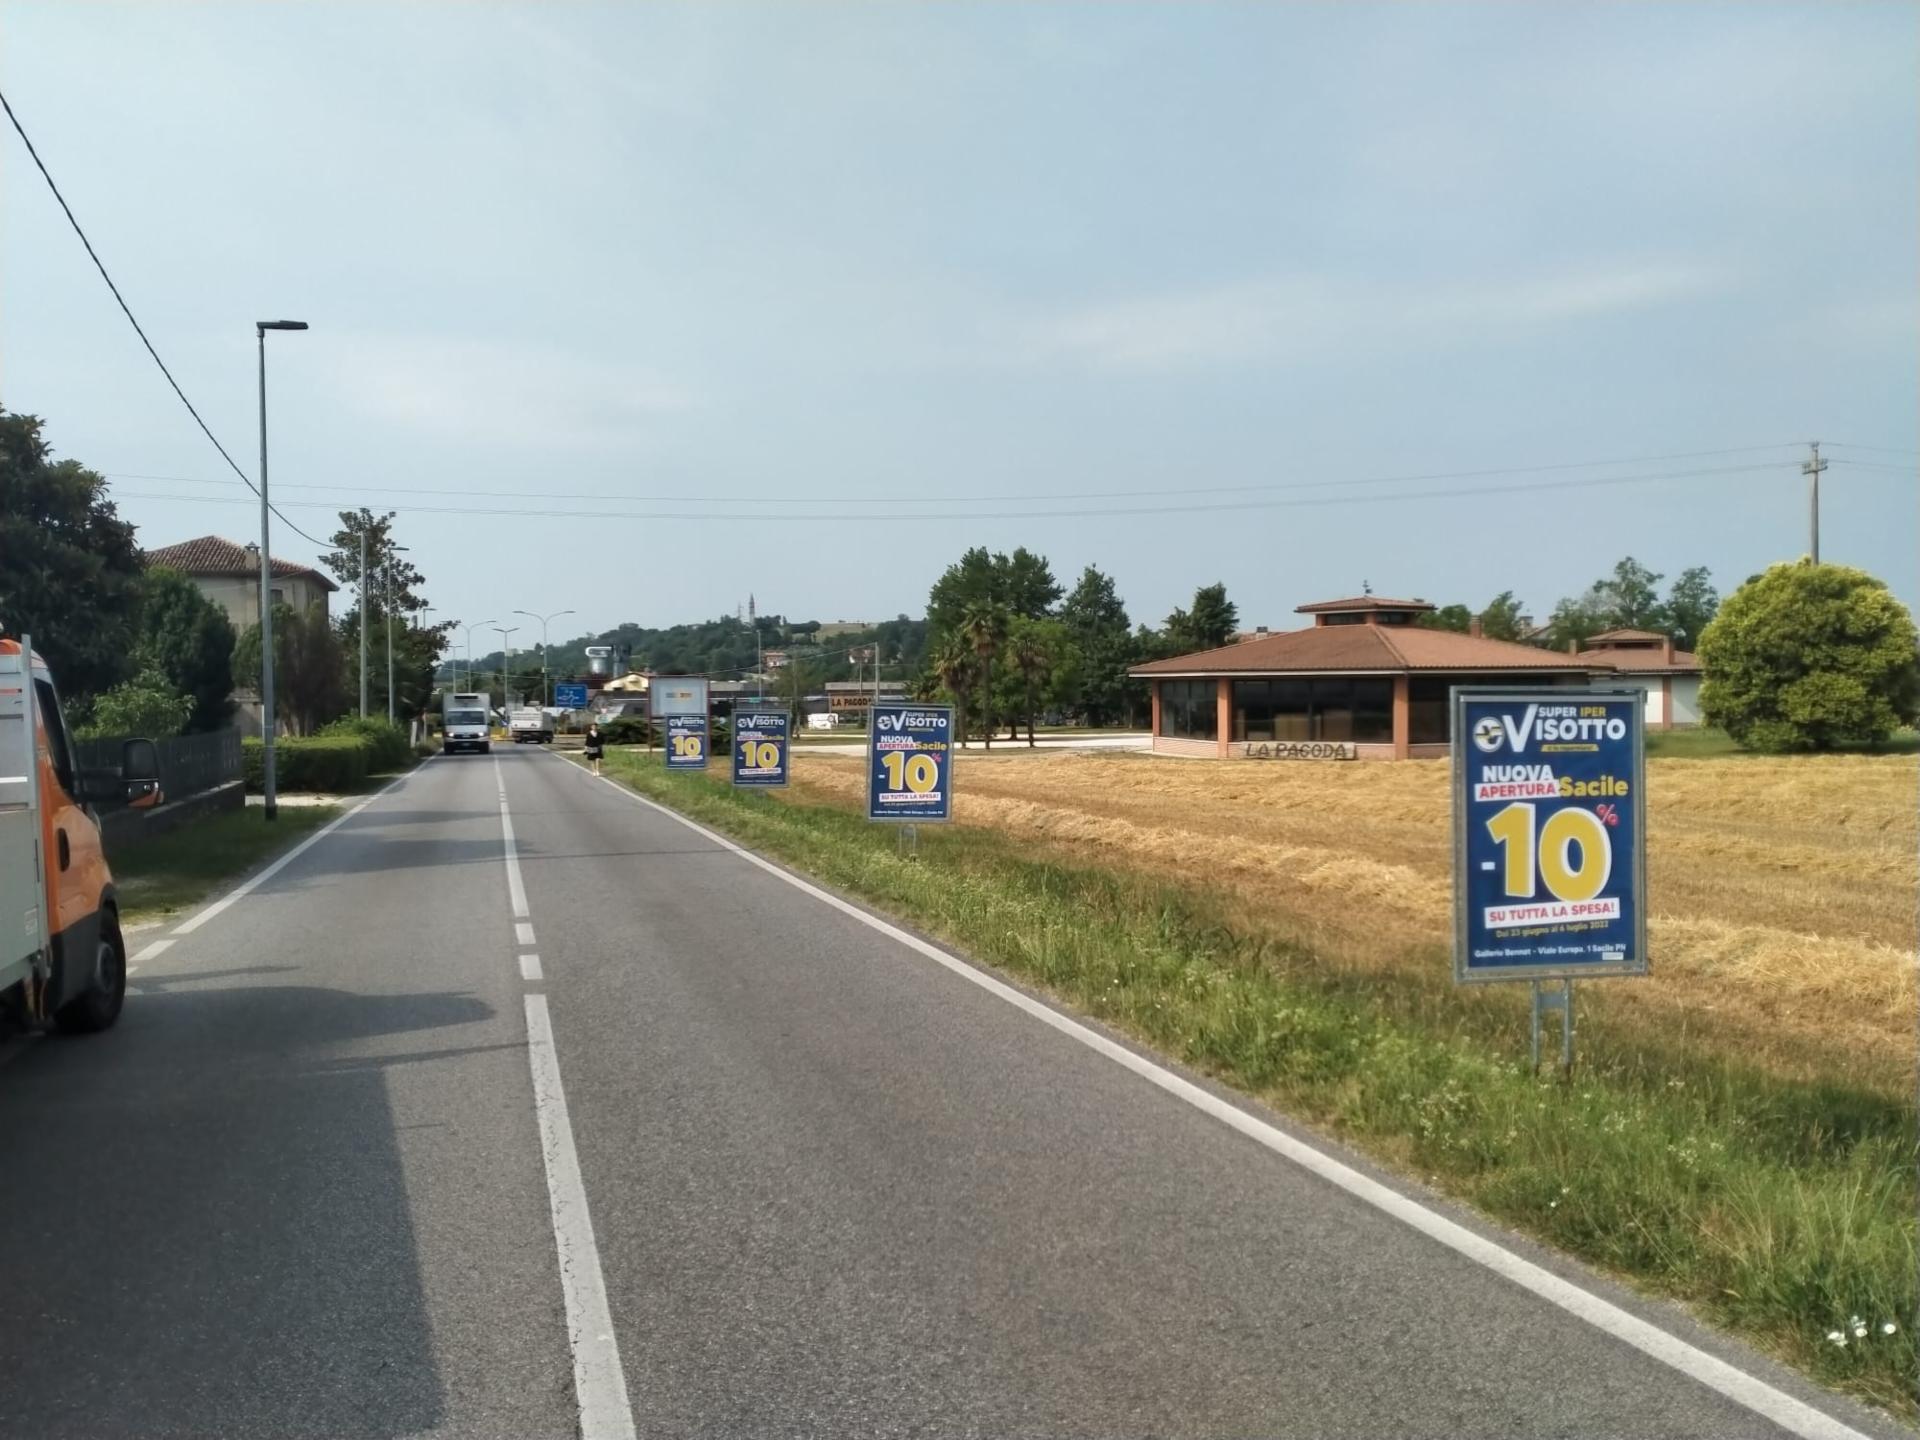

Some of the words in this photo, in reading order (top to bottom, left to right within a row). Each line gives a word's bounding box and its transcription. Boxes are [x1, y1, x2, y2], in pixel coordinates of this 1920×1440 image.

[891, 711, 947, 731] VISOTTO
[1538, 706, 1577, 717] SUPER
[1580, 706, 1606, 717] IPER
[1502, 703, 1626, 753] VISOTTO
[880, 735, 914, 743] NUOVA
[1246, 743, 1270, 757] LA
[1275, 743, 1346, 758] PAGODA
[1482, 764, 1554, 782] NUOVA
[1479, 782, 1556, 799] APERTURA
[1559, 775, 1629, 798] Sacile
[1489, 911, 1505, 922] SU
[1510, 907, 1549, 920] TUTTA
[1552, 905, 1568, 917] LA
[1571, 902, 1615, 916] SPESA!
